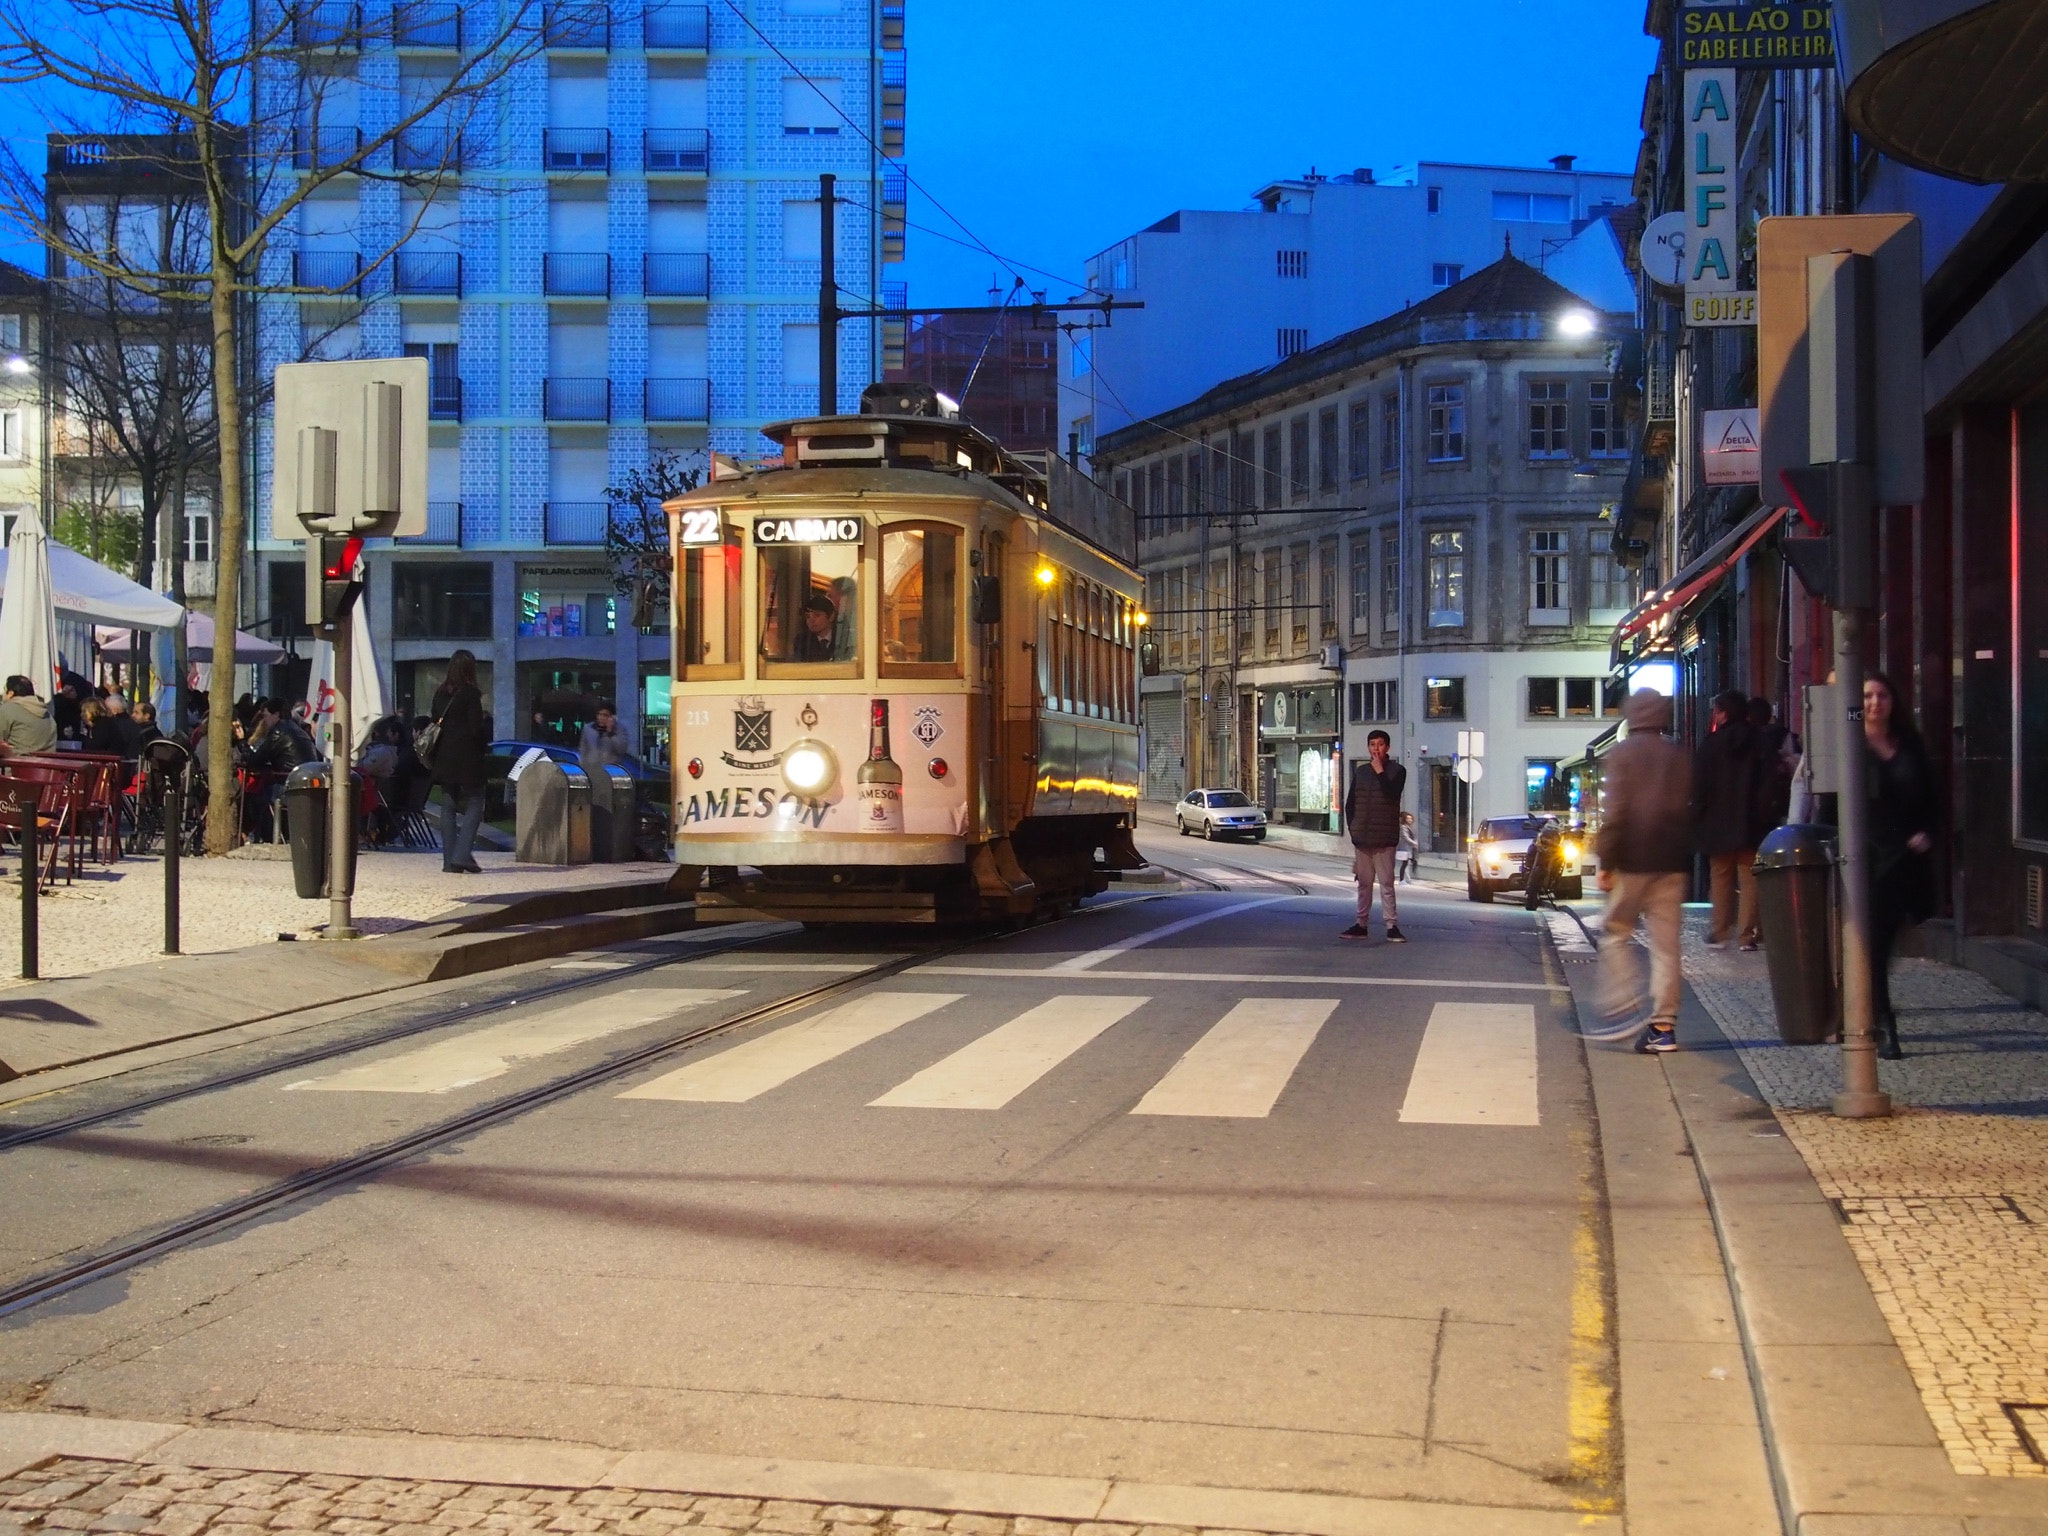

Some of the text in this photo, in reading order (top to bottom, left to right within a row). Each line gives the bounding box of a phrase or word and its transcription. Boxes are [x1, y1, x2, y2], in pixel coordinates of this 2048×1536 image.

[1684, 7, 1789, 34] SALÃO
[1684, 36, 1834, 61] CABELEIREIR
[1692, 79, 1730, 280] ALFA
[1692, 297, 1754, 321] COIFF
[1726, 436, 1751, 444] DELTA
[682, 510, 719, 543] 22
[522, 567, 613, 575] PAPELARIA CRIATIVA
[687, 711, 709, 726] 213
[858, 789, 899, 801] JAMESON
[675, 787, 831, 832] JAMESON
